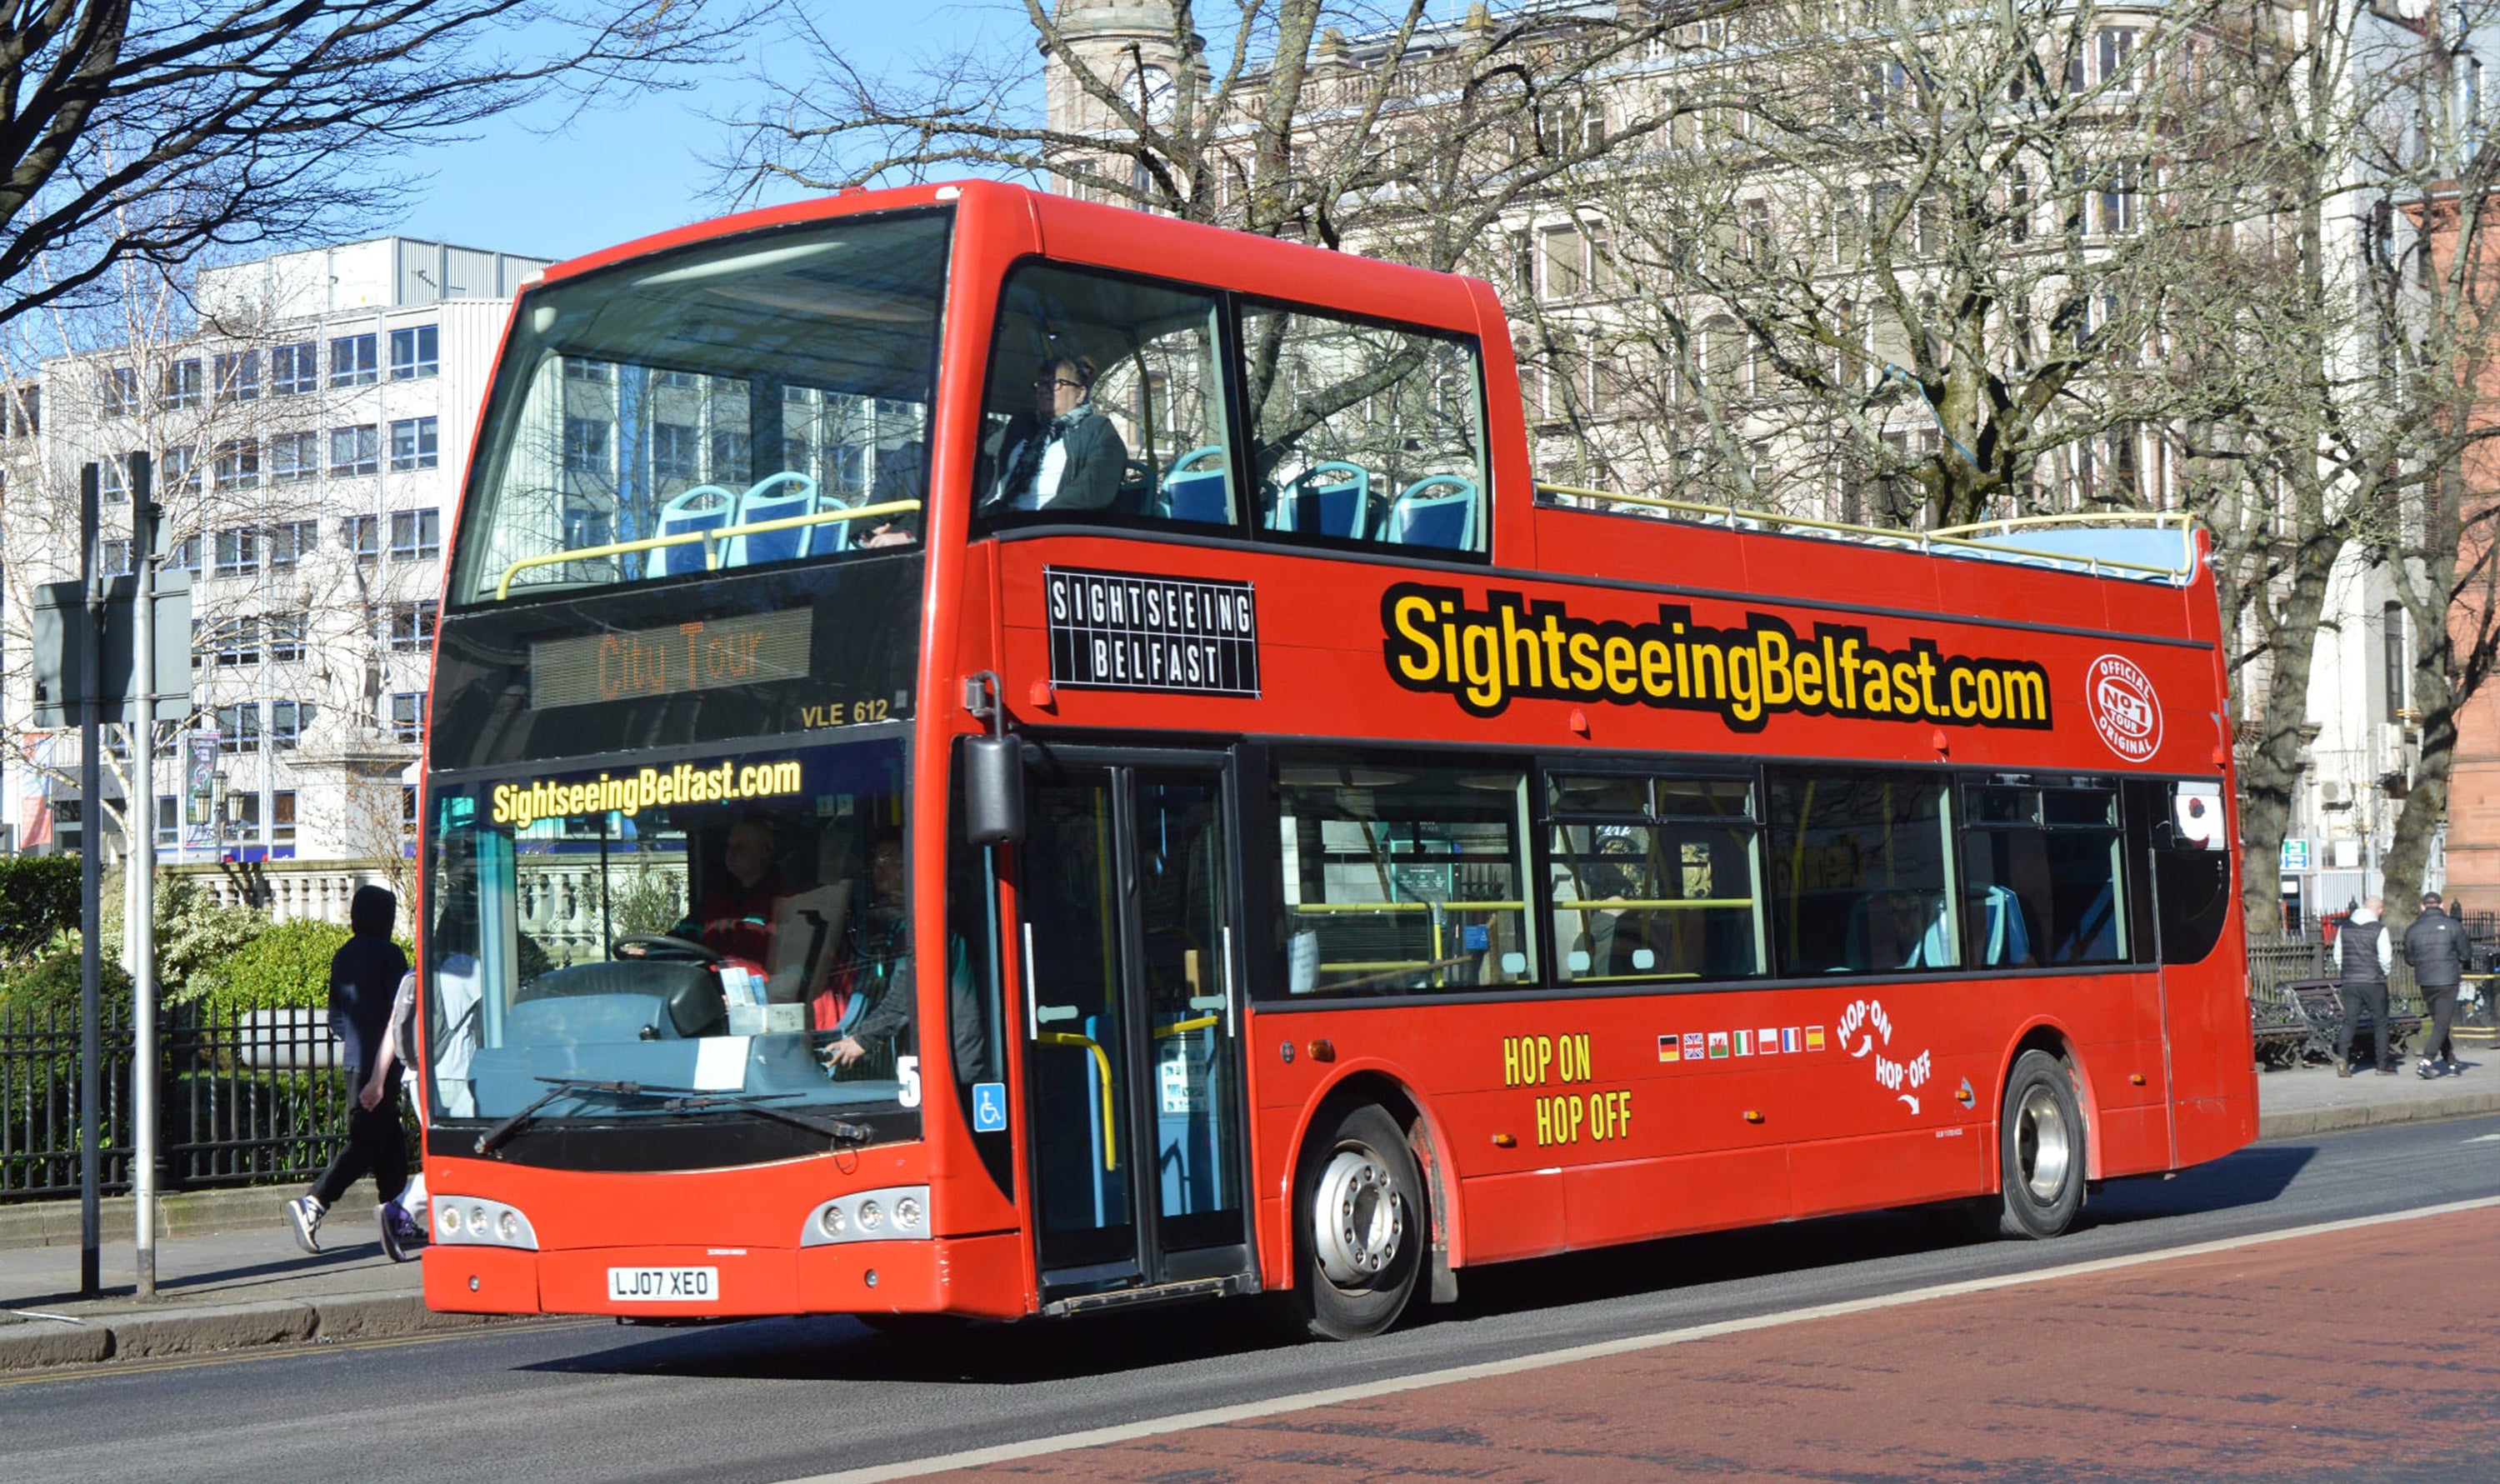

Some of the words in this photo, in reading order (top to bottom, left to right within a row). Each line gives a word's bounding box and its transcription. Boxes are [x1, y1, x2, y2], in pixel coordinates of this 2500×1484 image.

[1052, 581, 1250, 632] SIGHTSEEING
[598, 633, 664, 701] City
[679, 621, 762, 690] Tour
[1094, 639, 1217, 683] BELFAST
[1394, 595, 2048, 722] SightseeingBelfast.com
[2100, 660, 2151, 699] OFFICIAL
[802, 702, 844, 727] VLE
[853, 698, 889, 722] 612
[2099, 716, 2152, 755] ORIGINAL
[2110, 709, 2138, 733] TOUR
[492, 760, 802, 828] SightseeingBelfast.com
[897, 1055, 921, 1107] 5
[1503, 1035, 1552, 1086] HOP
[1558, 1033, 1591, 1082] ON
[1536, 1094, 1583, 1146] HOP
[1589, 1090, 1631, 1141] OFF
[616, 1271, 663, 1296] LJ07
[670, 1271, 708, 1296] XEO
